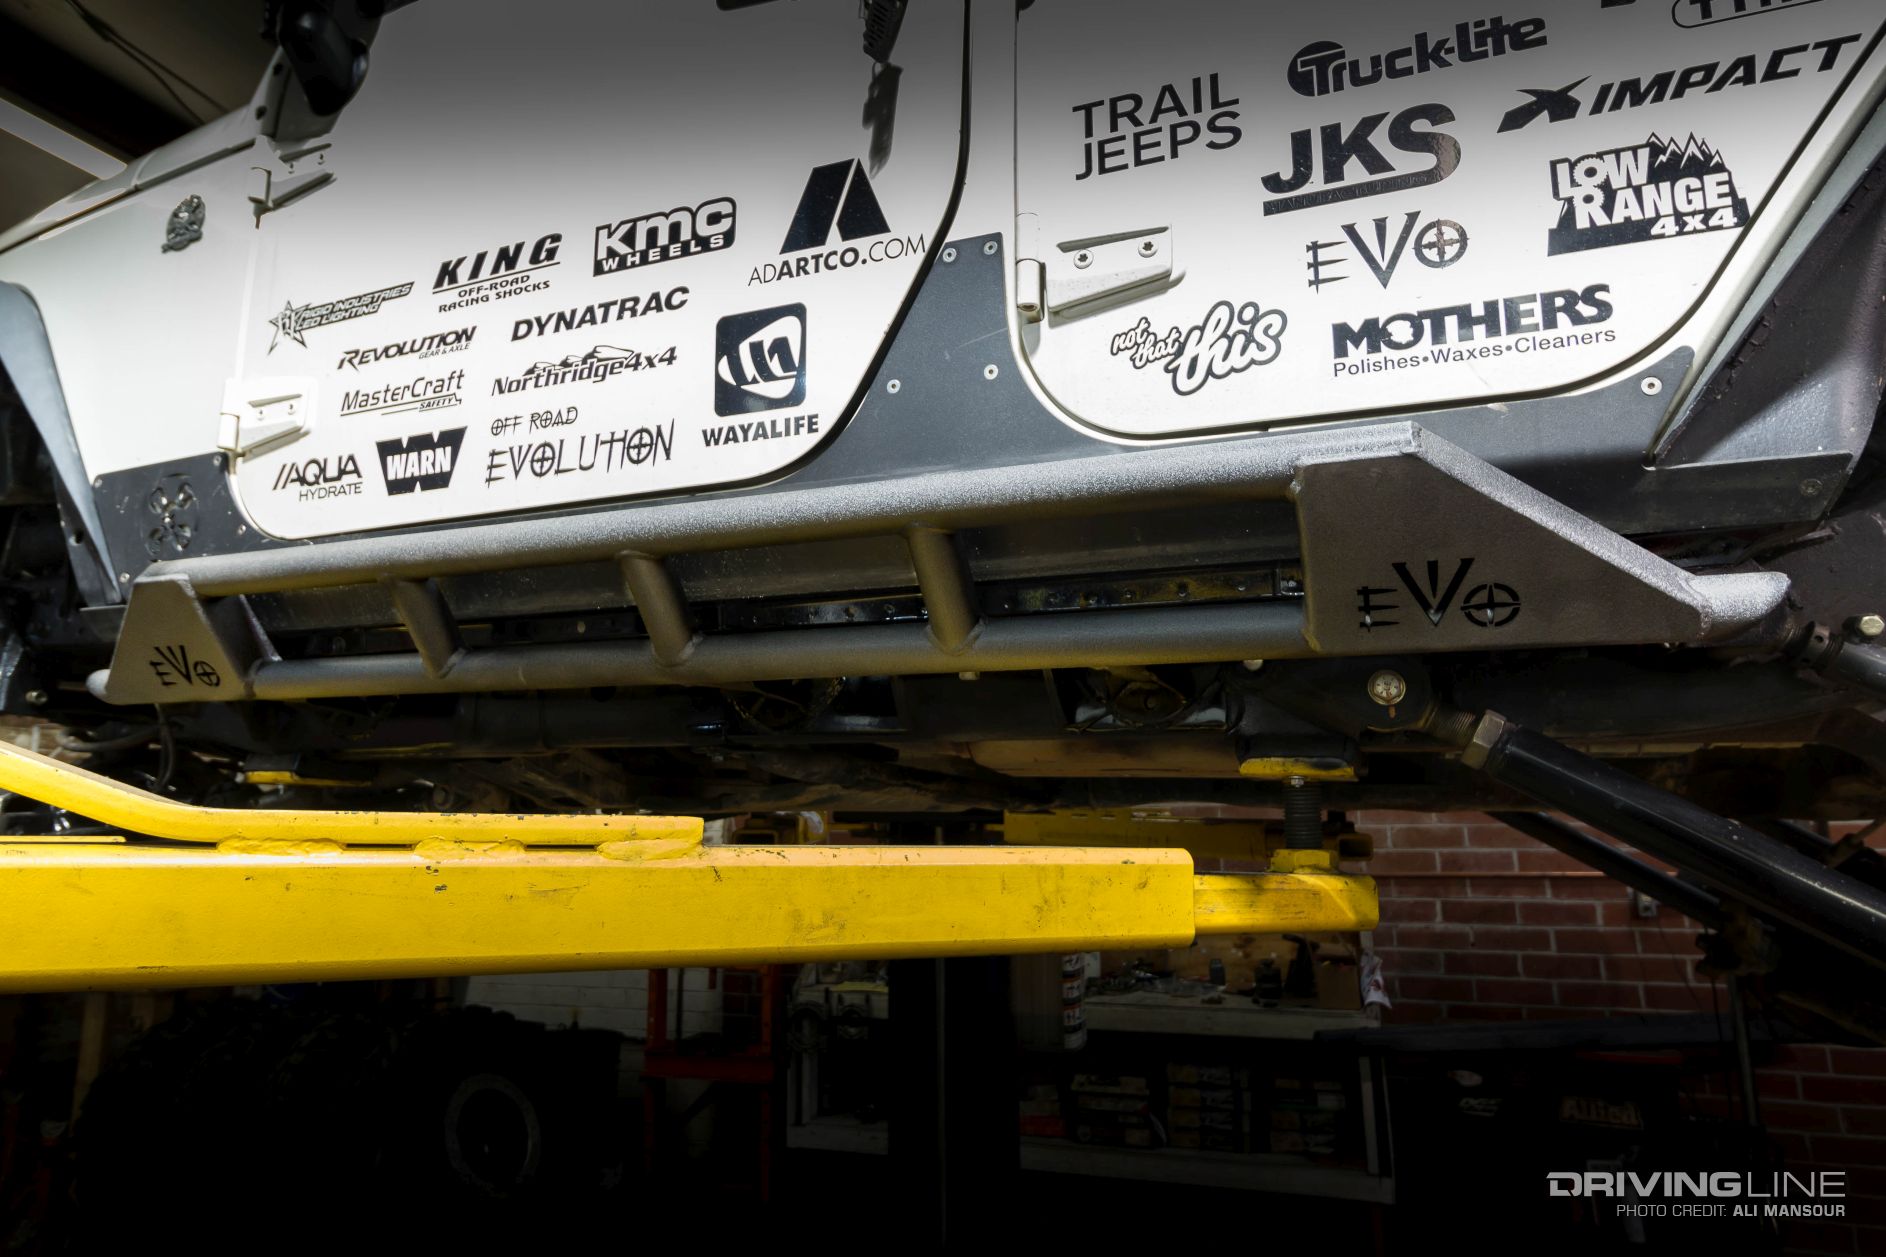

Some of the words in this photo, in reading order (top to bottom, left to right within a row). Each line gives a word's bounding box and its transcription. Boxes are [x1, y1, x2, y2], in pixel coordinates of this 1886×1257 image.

[1288, 16, 1547, 97] Truck-Lite
[1589, 33, 1862, 116] IMPACT
[1072, 72, 1240, 139] TRAIL
[1075, 110, 1243, 181] JEEPS
[1261, 102, 1461, 194] JKS
[1555, 146, 1650, 198] LOW
[1563, 171, 1734, 230] RANGE
[432, 233, 562, 290] KING
[601, 233, 725, 272] WHEELS
[748, 233, 926, 286] ADARTCO.COM
[301, 305, 333, 320] RIGID
[333, 284, 412, 311] INDUSTRIES
[438, 294, 490, 313] RACING
[495, 280, 550, 301] SHOCKS
[458, 274, 530, 298] OFF-ROAD
[296, 317, 321, 331] LED
[322, 303, 380, 326] LIGHTING
[511, 286, 690, 342] DYNATRAC
[1111, 317, 1151, 355] not
[1331, 283, 1614, 359] MOTHERS
[337, 325, 478, 371] REVOLUTION
[419, 348, 441, 360] GEAR
[449, 342, 471, 354] AXLE
[1130, 326, 1182, 369] that
[1164, 300, 1288, 396] this
[341, 369, 465, 412] MasterCraft
[419, 396, 455, 410] SAFETY
[491, 412, 523, 437] OFF
[530, 406, 579, 428] ROAD
[702, 413, 820, 448] WAYALIFE
[386, 445, 453, 481] WARN
[485, 418, 676, 488] EVOLUTION
[299, 482, 362, 501] HYDRATE
